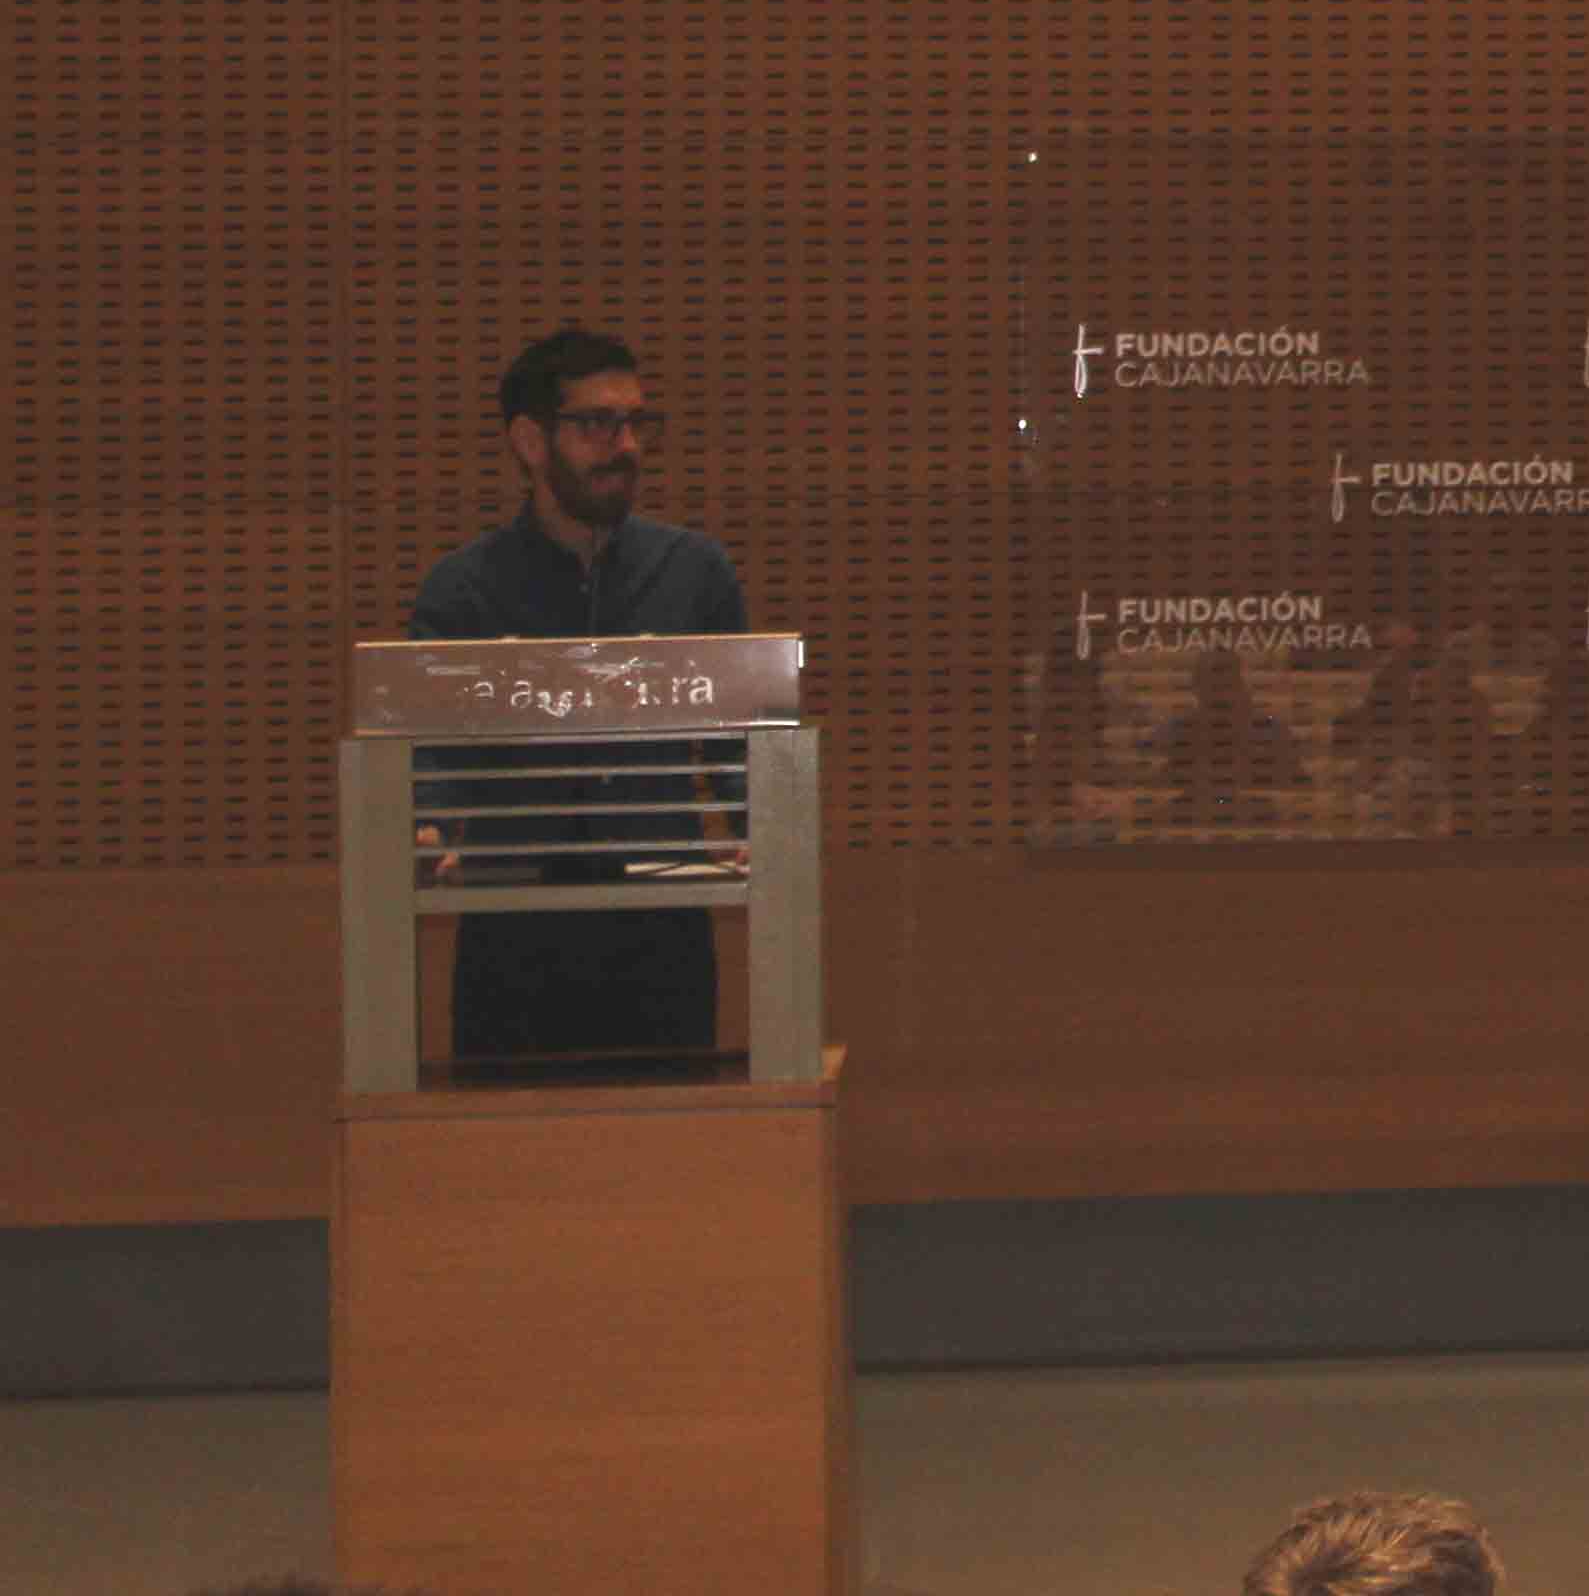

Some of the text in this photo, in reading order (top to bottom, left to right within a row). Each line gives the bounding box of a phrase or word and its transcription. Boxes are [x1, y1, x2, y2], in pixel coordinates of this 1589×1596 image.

[1115, 326, 1320, 357] FUNDACIÓN
[1114, 359, 1369, 389] CAJANAVARRA
[1371, 456, 1574, 487] FUNDACIÓN
[1118, 593, 1321, 624] FUNDACIÓN
[1117, 625, 1371, 653] CAJANAVARRA
